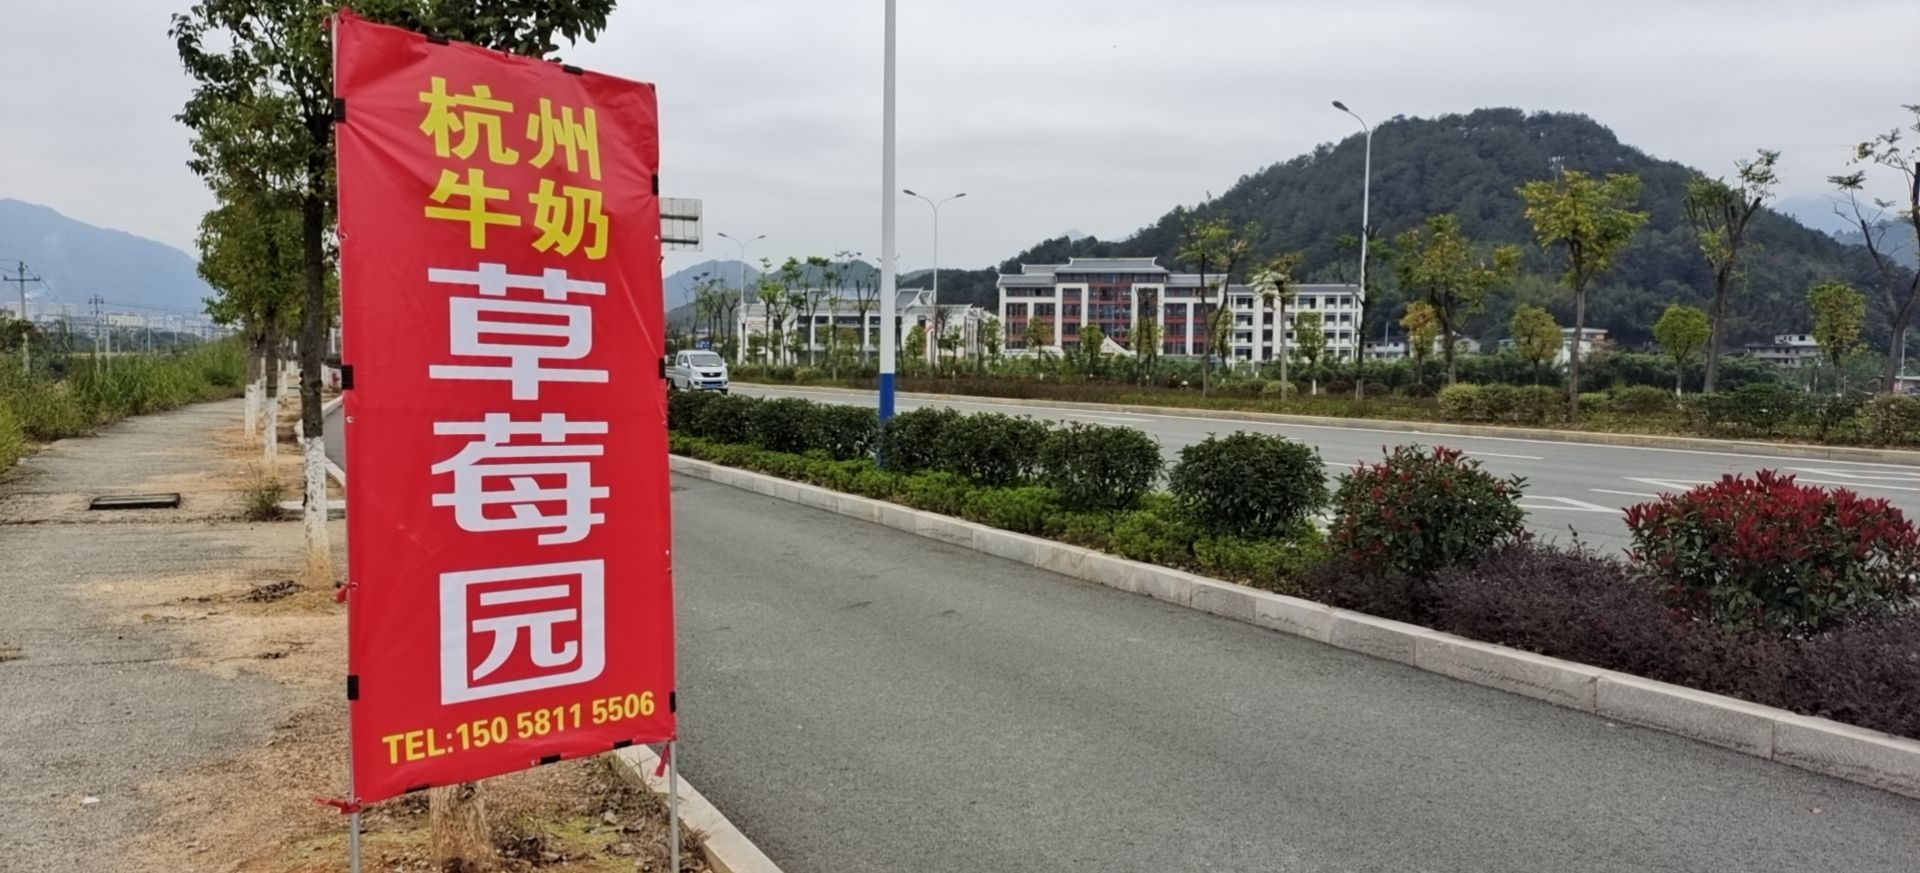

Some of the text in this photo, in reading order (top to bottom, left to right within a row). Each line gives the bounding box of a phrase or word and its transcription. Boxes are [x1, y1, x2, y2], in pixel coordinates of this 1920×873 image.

[418, 76, 604, 182] 杭州
[425, 168, 609, 260] 牛奶
[427, 261, 611, 706] 草莓园
[517, 702, 582, 739] 5811
[592, 690, 656, 725] 5506
